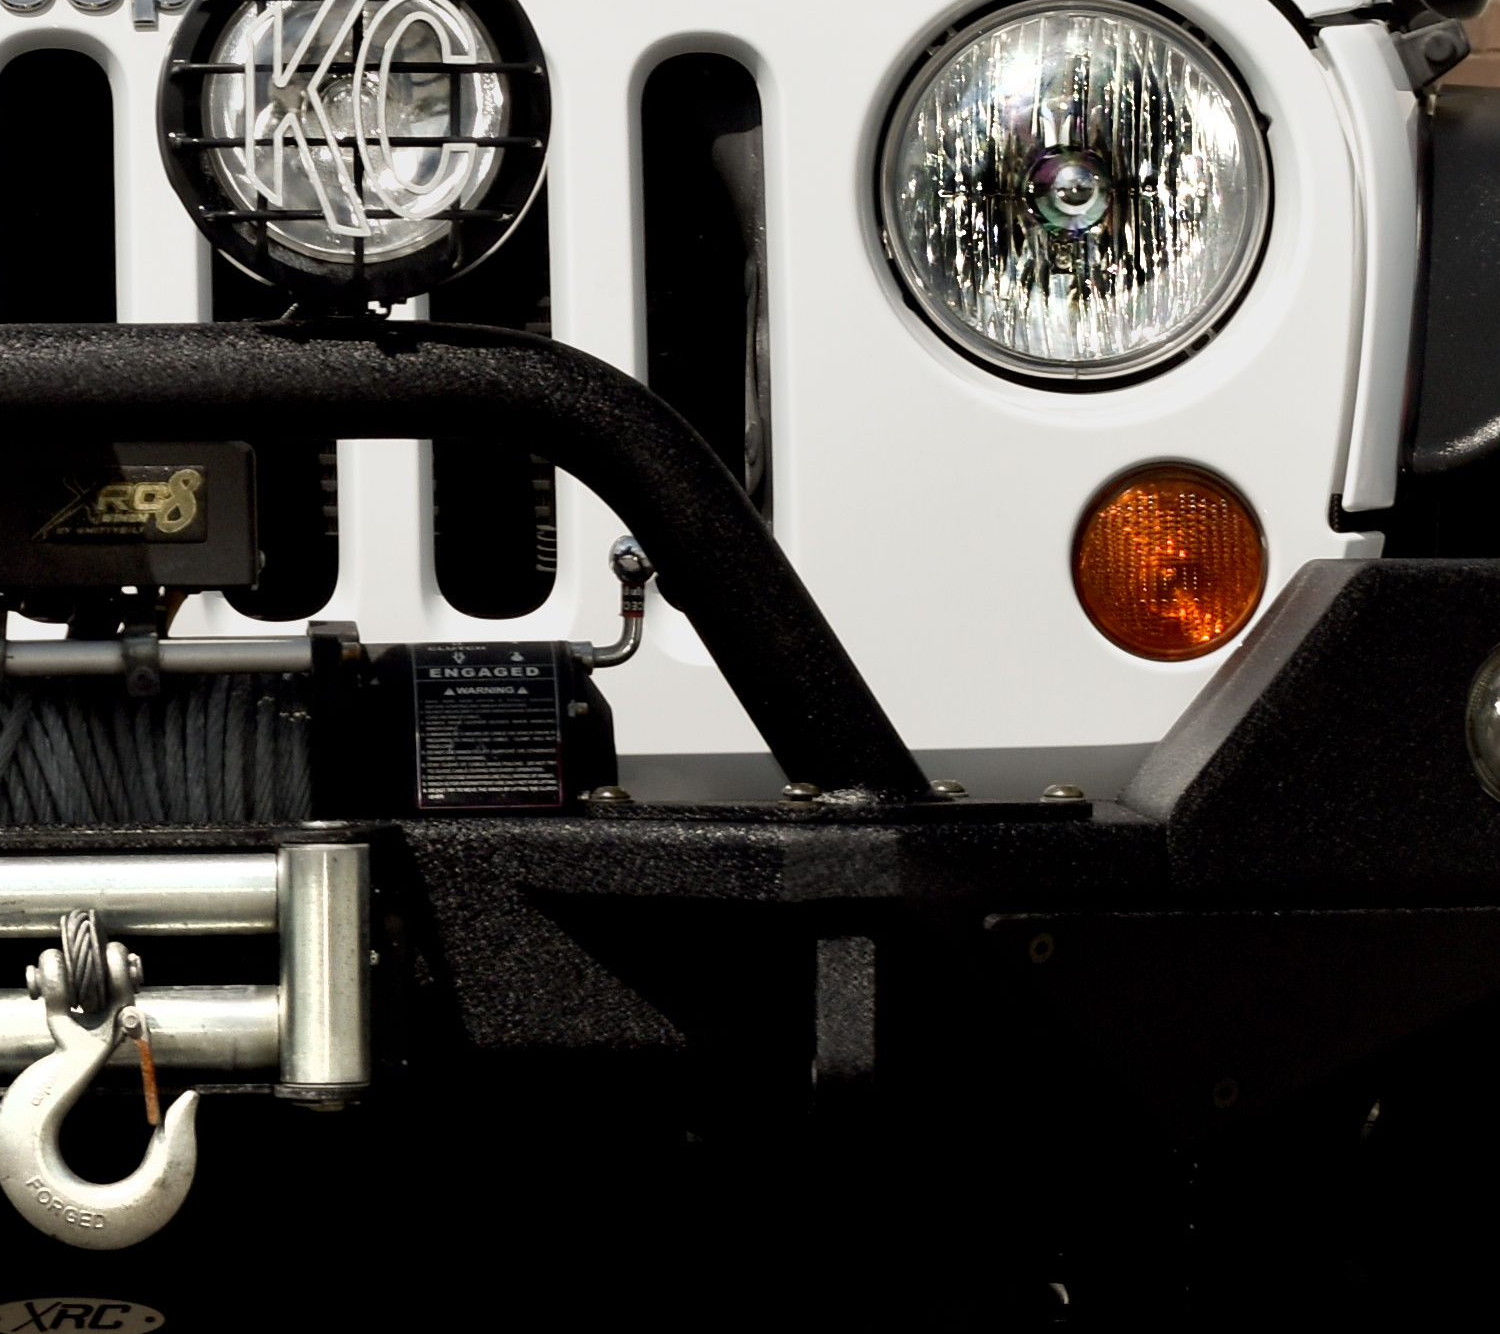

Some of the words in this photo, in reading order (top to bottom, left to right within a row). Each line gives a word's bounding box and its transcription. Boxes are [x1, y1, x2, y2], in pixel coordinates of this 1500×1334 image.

[429, 667, 540, 678] ENGAGED
[455, 686, 516, 695] WARNING
[24, 1174, 106, 1229] FORGED
[11, 1301, 132, 1333] XRC
